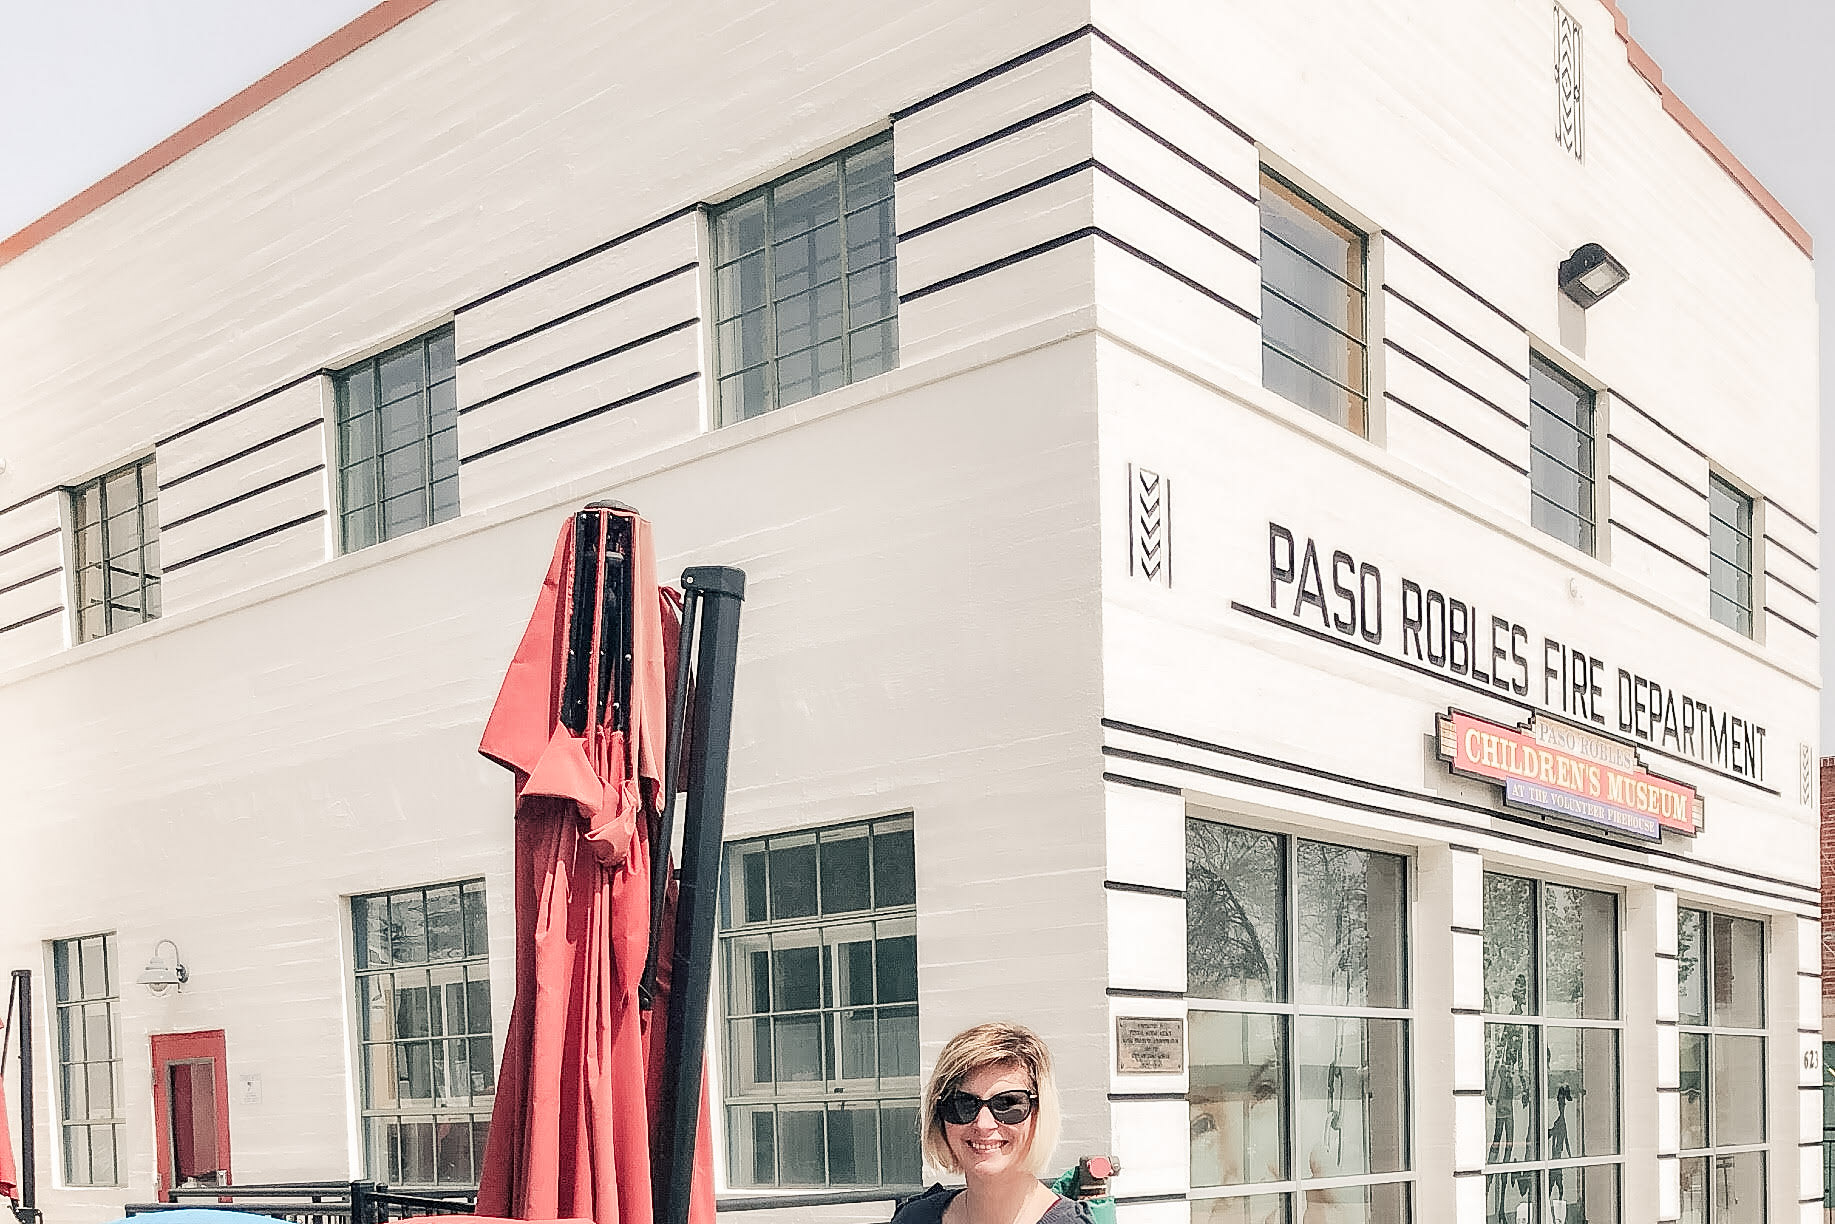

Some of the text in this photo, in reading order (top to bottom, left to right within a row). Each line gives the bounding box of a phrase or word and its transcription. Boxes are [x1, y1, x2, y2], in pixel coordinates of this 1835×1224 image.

[1269, 521, 1767, 782] PASO ROBLES FIRE DEPARTMENT
[1465, 728, 1688, 823] CHILDREN'S MUSEUM
[1539, 722, 1632, 769] PASO ROBLES
[1512, 784, 1655, 833] AT THE VOLUNTEER FIREHOUSE
